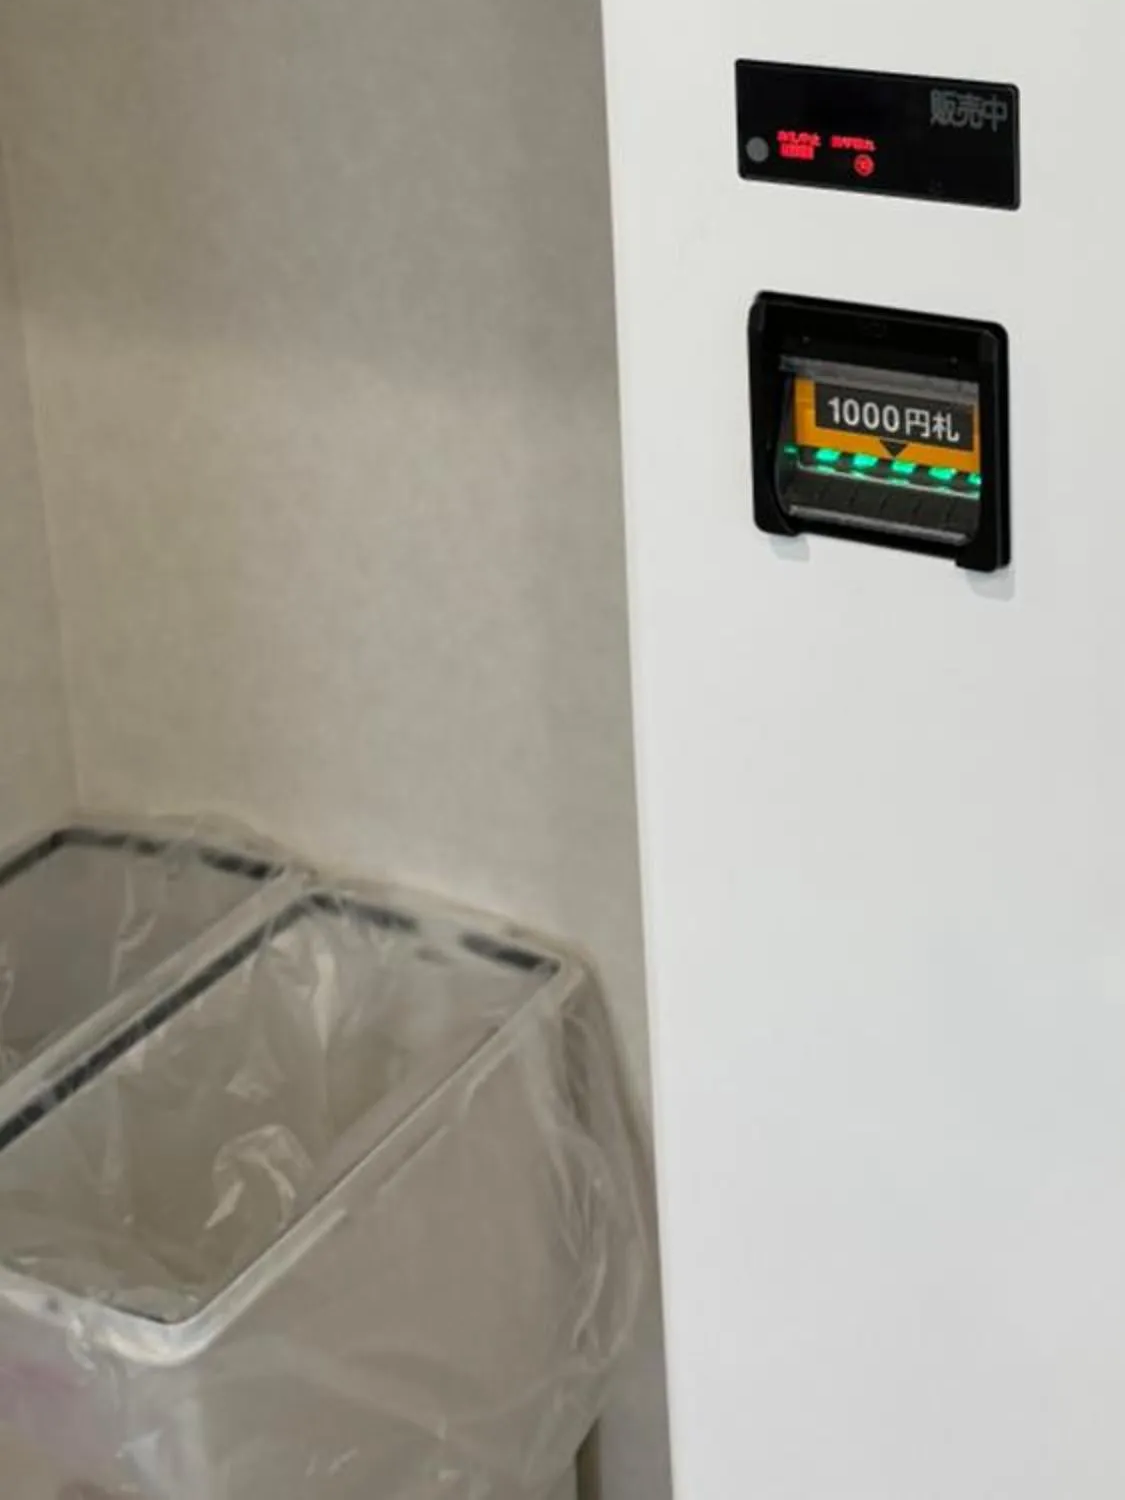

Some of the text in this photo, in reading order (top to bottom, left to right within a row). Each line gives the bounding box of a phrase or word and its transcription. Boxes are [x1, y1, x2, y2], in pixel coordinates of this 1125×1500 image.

[930, 89, 1008, 133] 販売中
[827, 396, 961, 442] 1000円札
